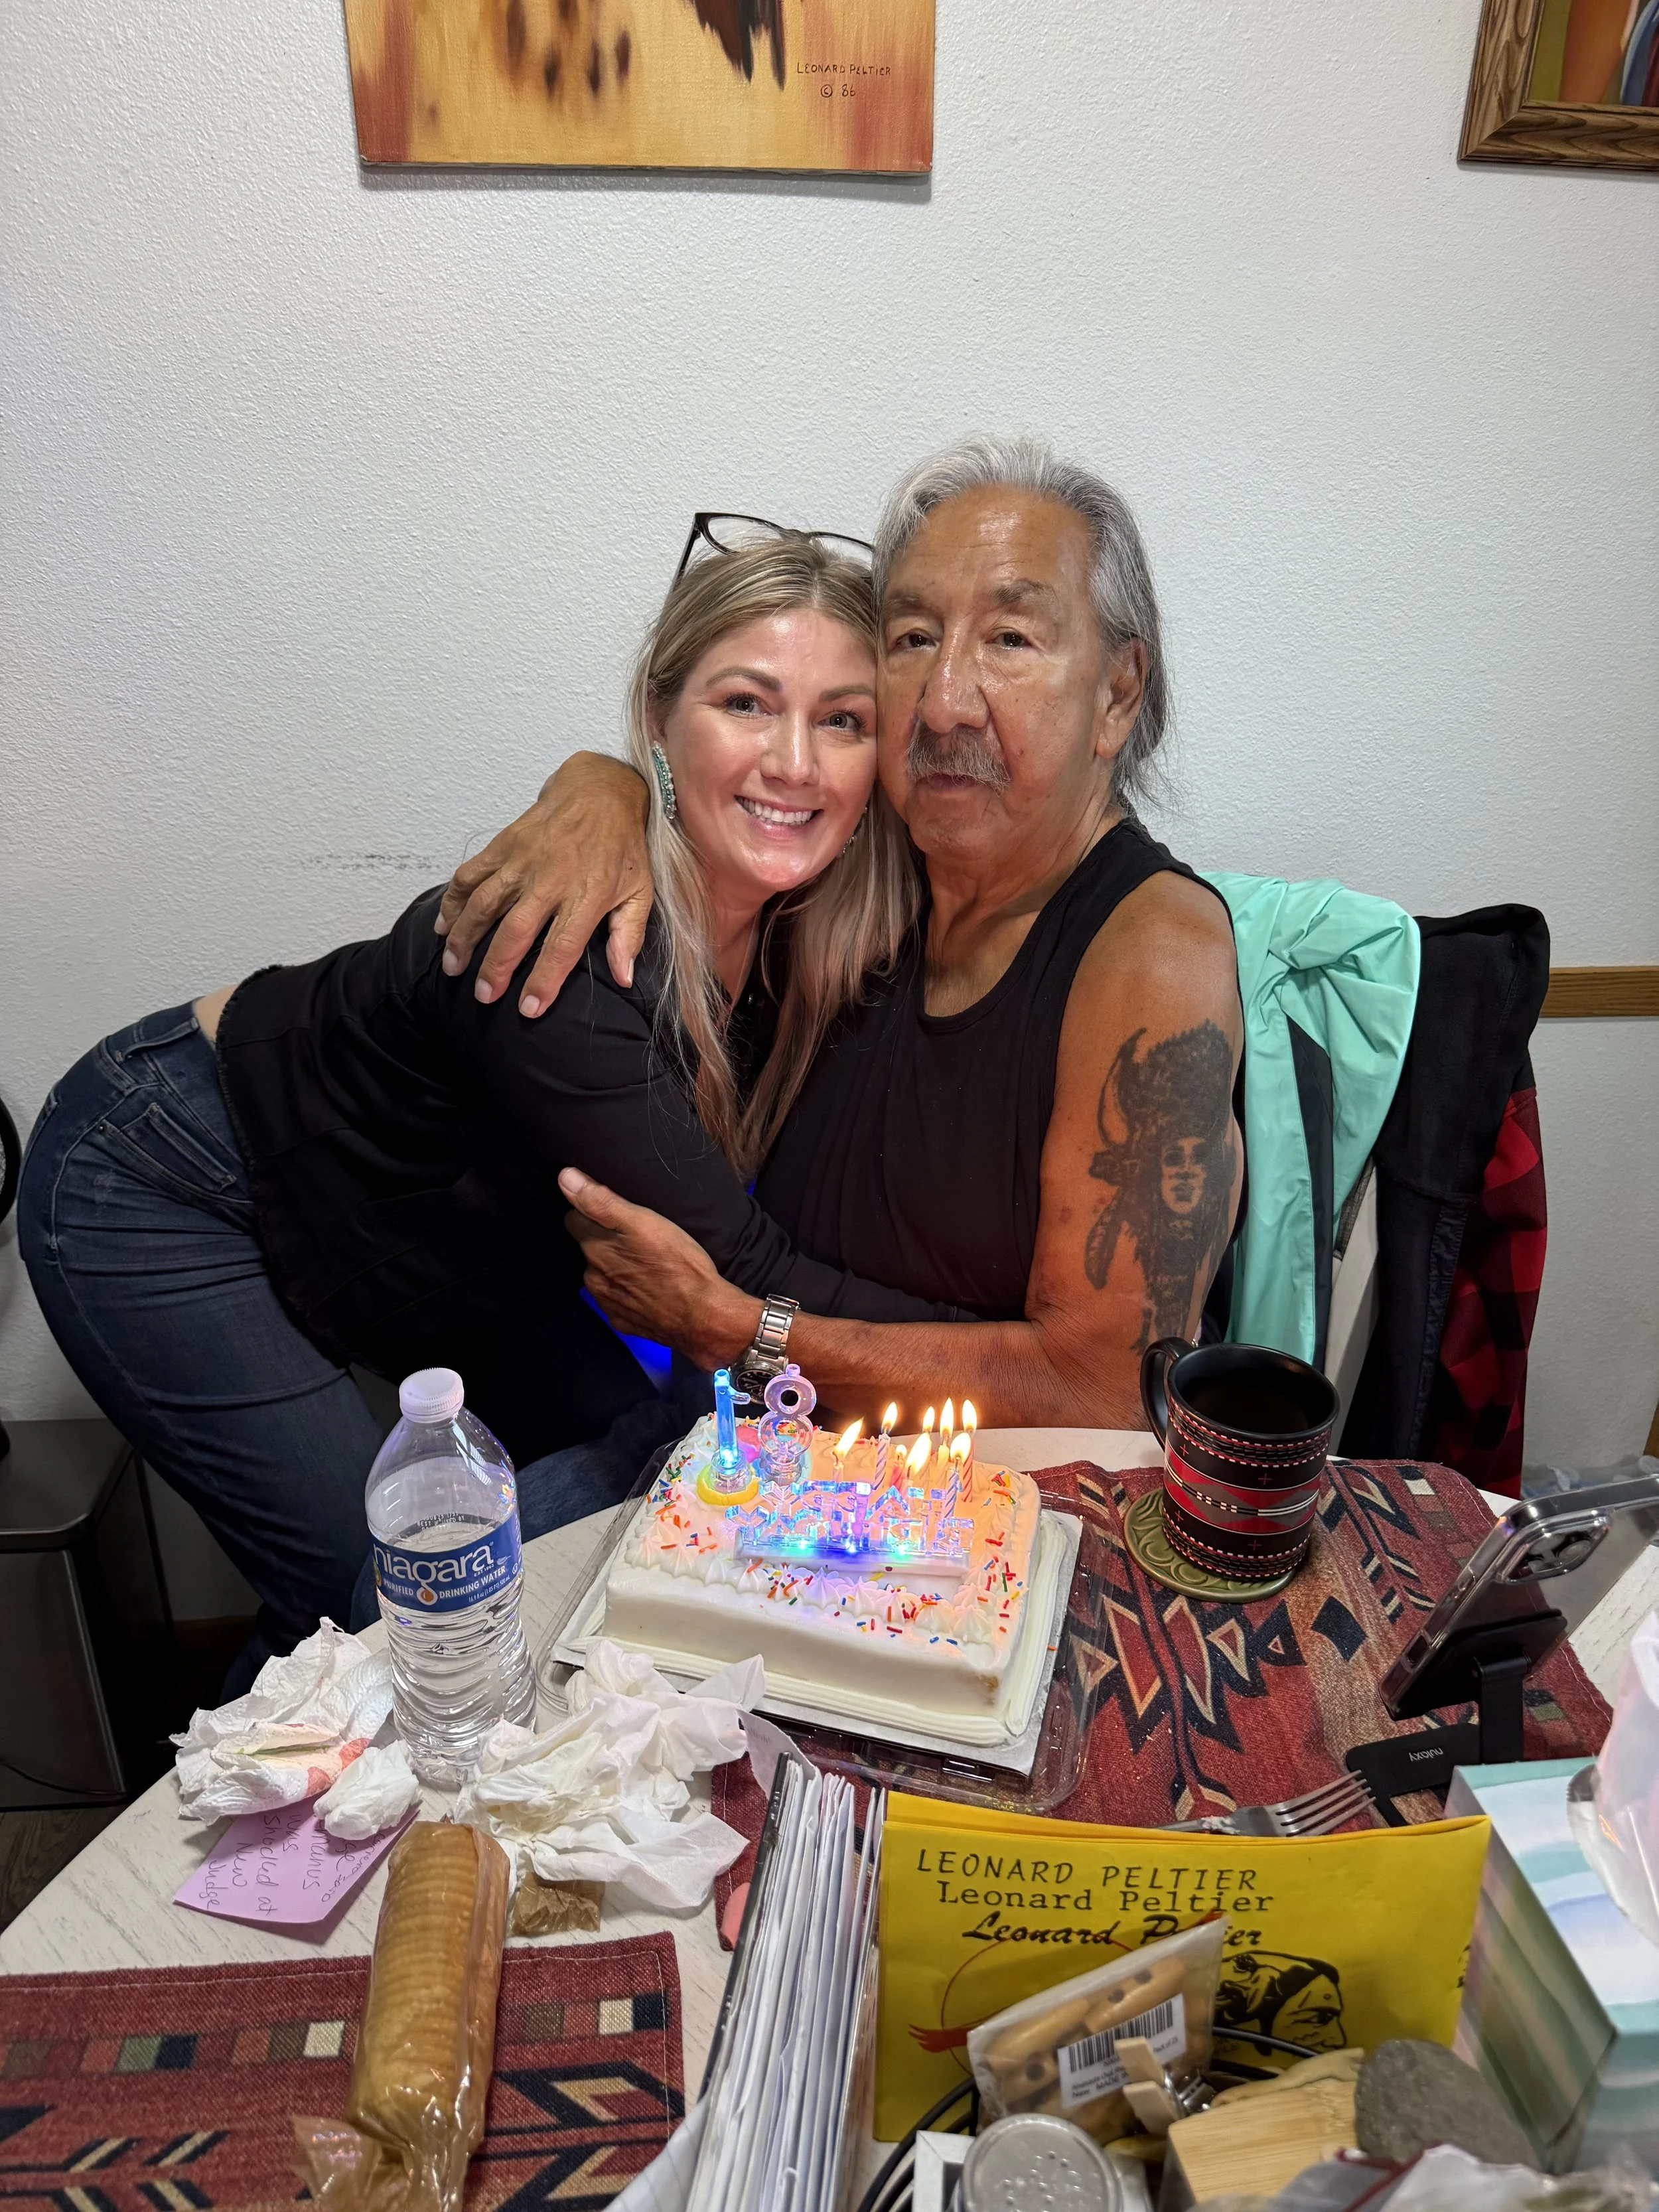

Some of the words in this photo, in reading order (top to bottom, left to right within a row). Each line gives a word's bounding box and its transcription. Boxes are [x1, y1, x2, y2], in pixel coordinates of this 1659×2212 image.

[796, 62, 845, 74] LEONARD
[849, 64, 891, 76] PELTIER
[841, 84, 856, 98] 86
[373, 1542, 494, 1593] niagara
[384, 1578, 414, 1596] PURIFIED
[439, 1579, 480, 1599] DRINKING
[480, 1566, 506, 1586] WATER
[1408, 1747, 1444, 1761] nulaxy
[916, 1848, 1074, 1885] LEONARD
[1102, 1865, 1258, 1891] PELTIER
[937, 1880, 1094, 1911] Leonard
[1119, 1890, 1274, 1913] Peltier
[962, 1910, 1121, 1946] Leonard
